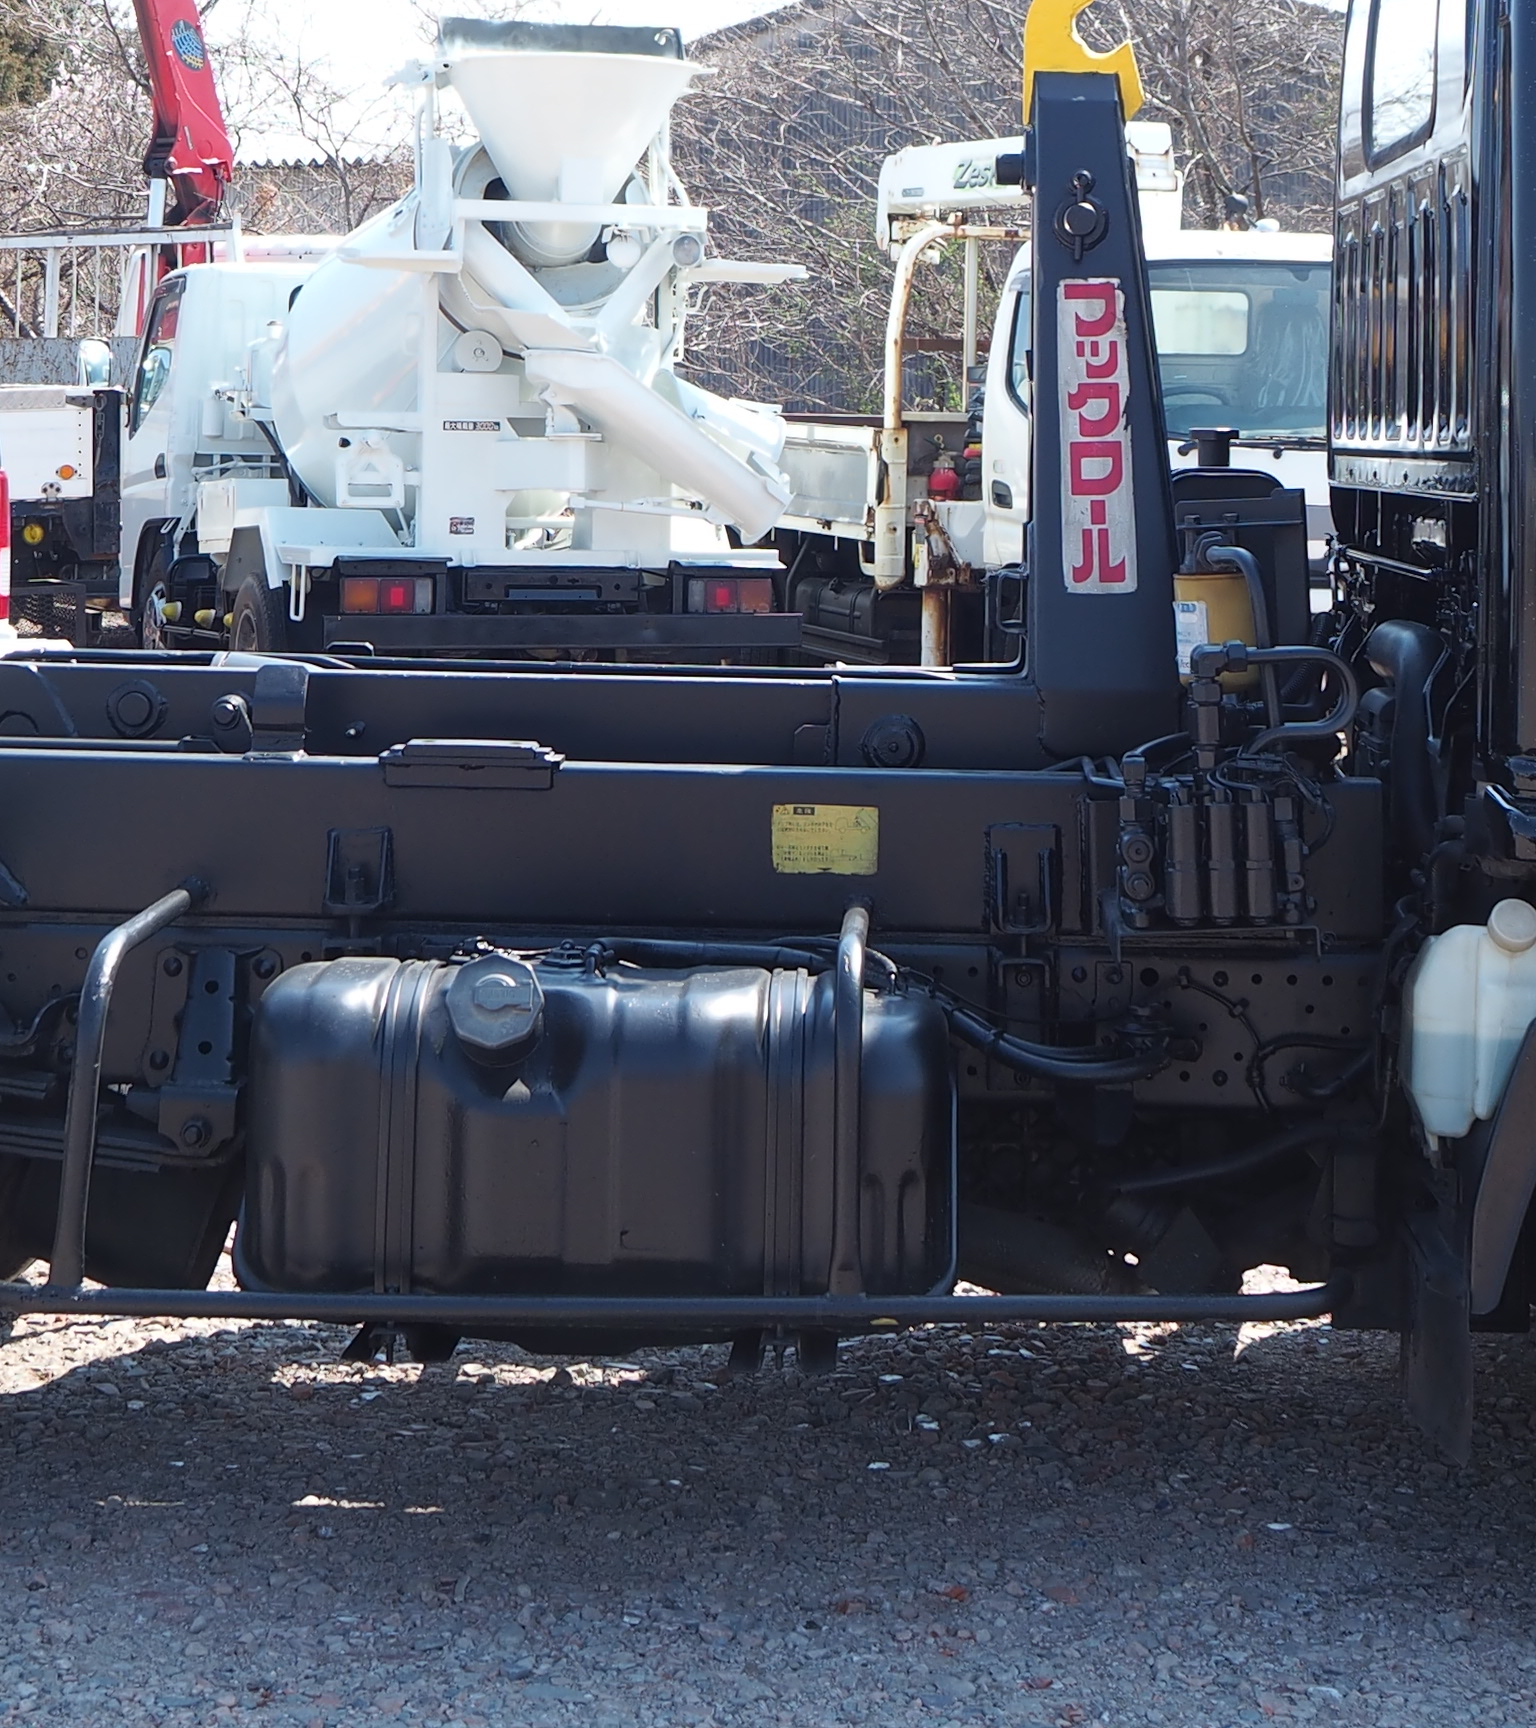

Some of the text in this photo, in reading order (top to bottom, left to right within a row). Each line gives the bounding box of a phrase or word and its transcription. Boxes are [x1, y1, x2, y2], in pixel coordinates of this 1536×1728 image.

[1064, 283, 1127, 584] フックロール
